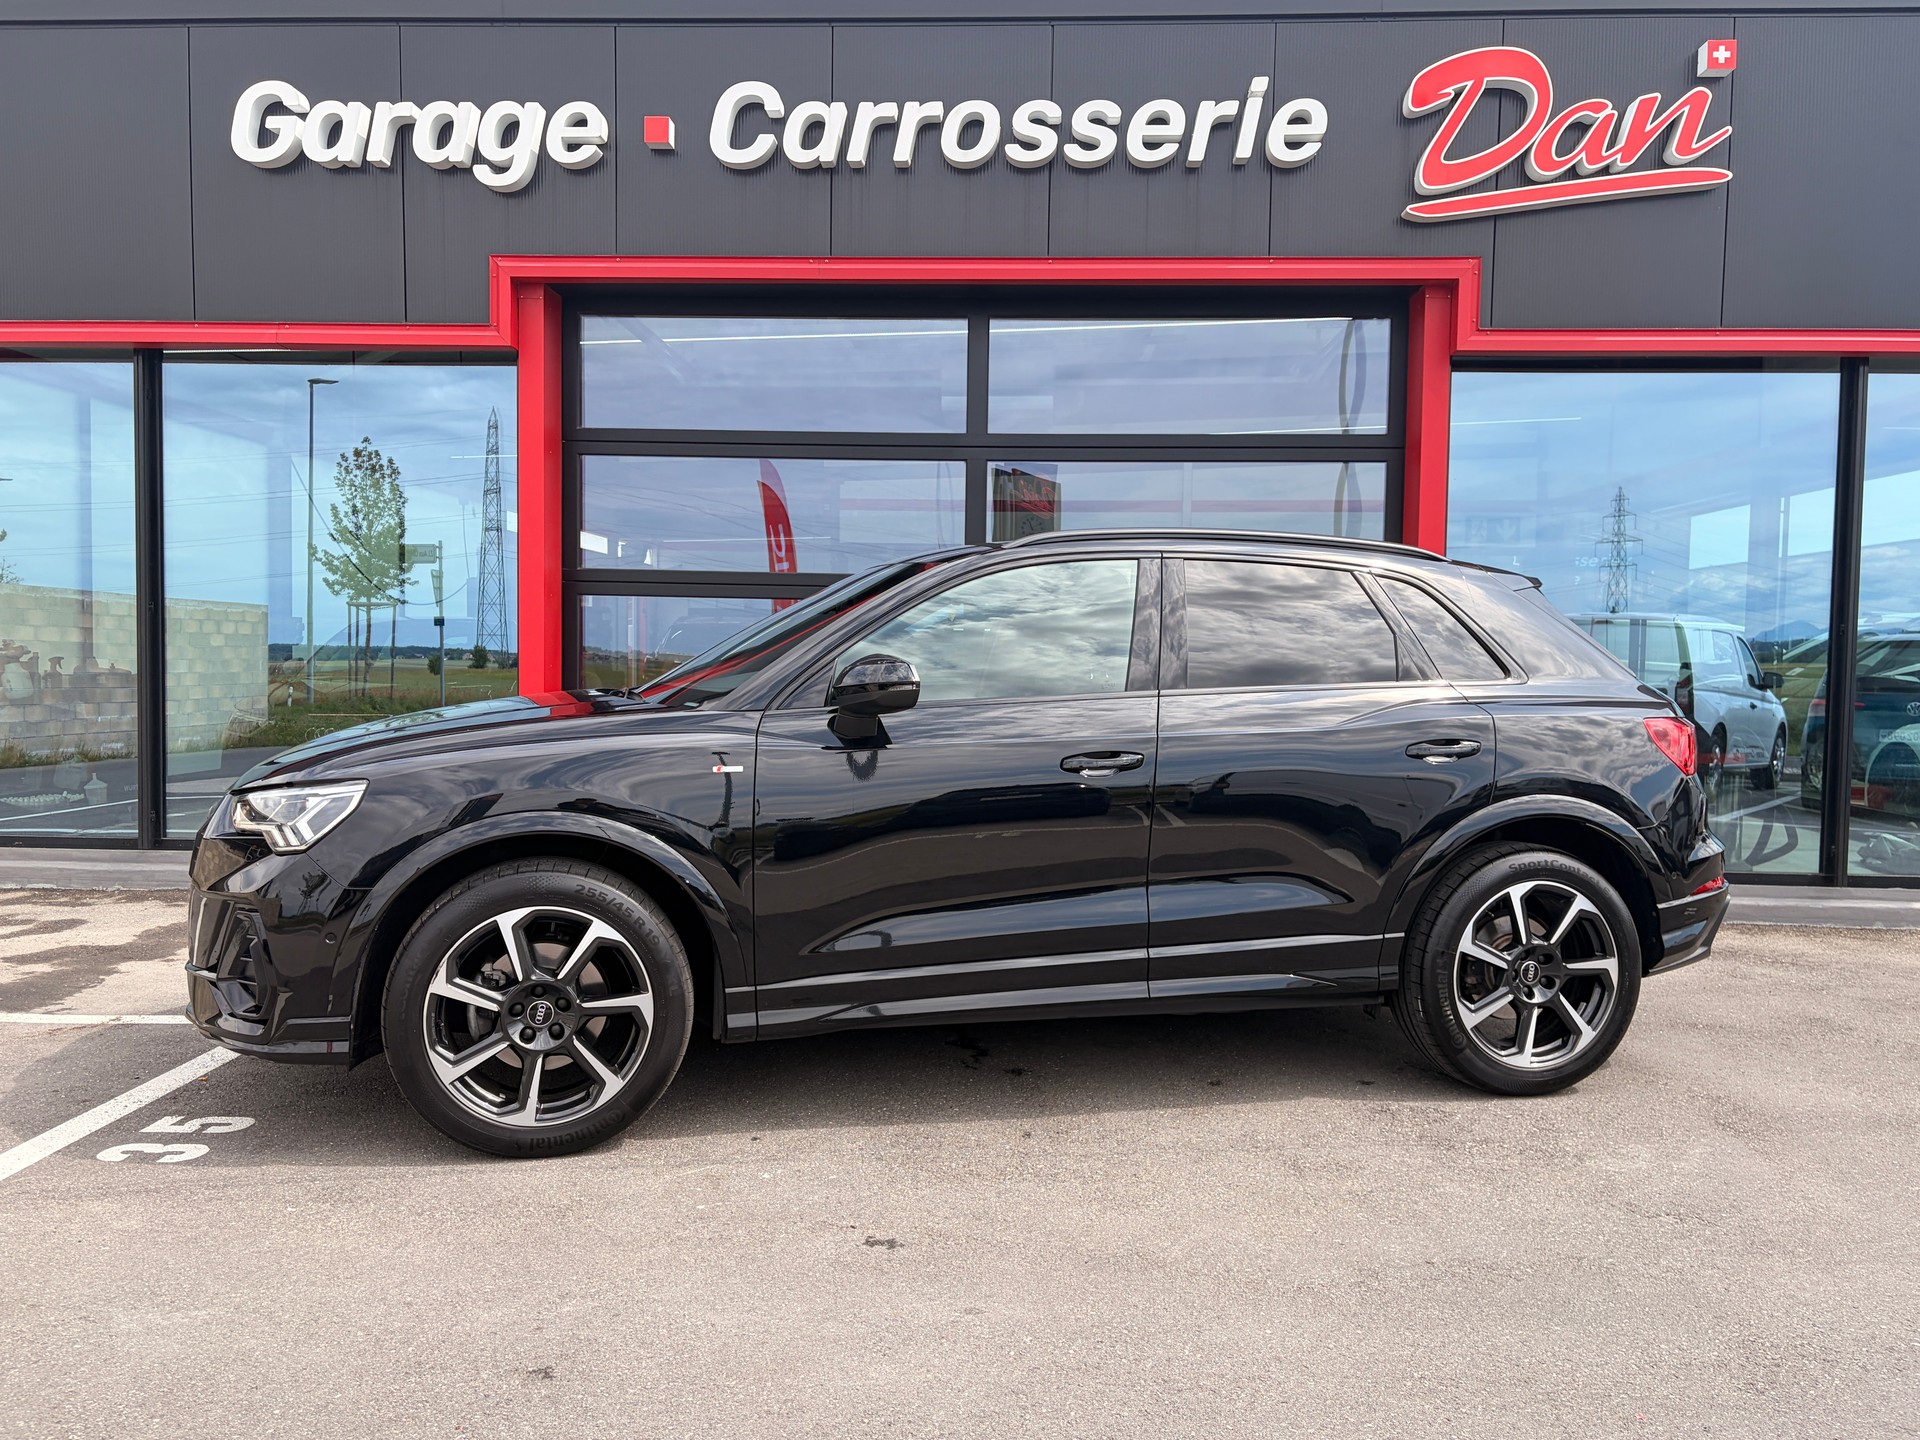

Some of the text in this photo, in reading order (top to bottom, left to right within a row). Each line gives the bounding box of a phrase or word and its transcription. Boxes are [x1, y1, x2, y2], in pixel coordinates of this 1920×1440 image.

[230, 80, 610, 193] Garage
[708, 76, 1330, 170] Carrosserie
[574, 884, 661, 947] 255/45 R 19
[96, 1115, 256, 1163] 35
[529, 1108, 627, 1152] Continental
